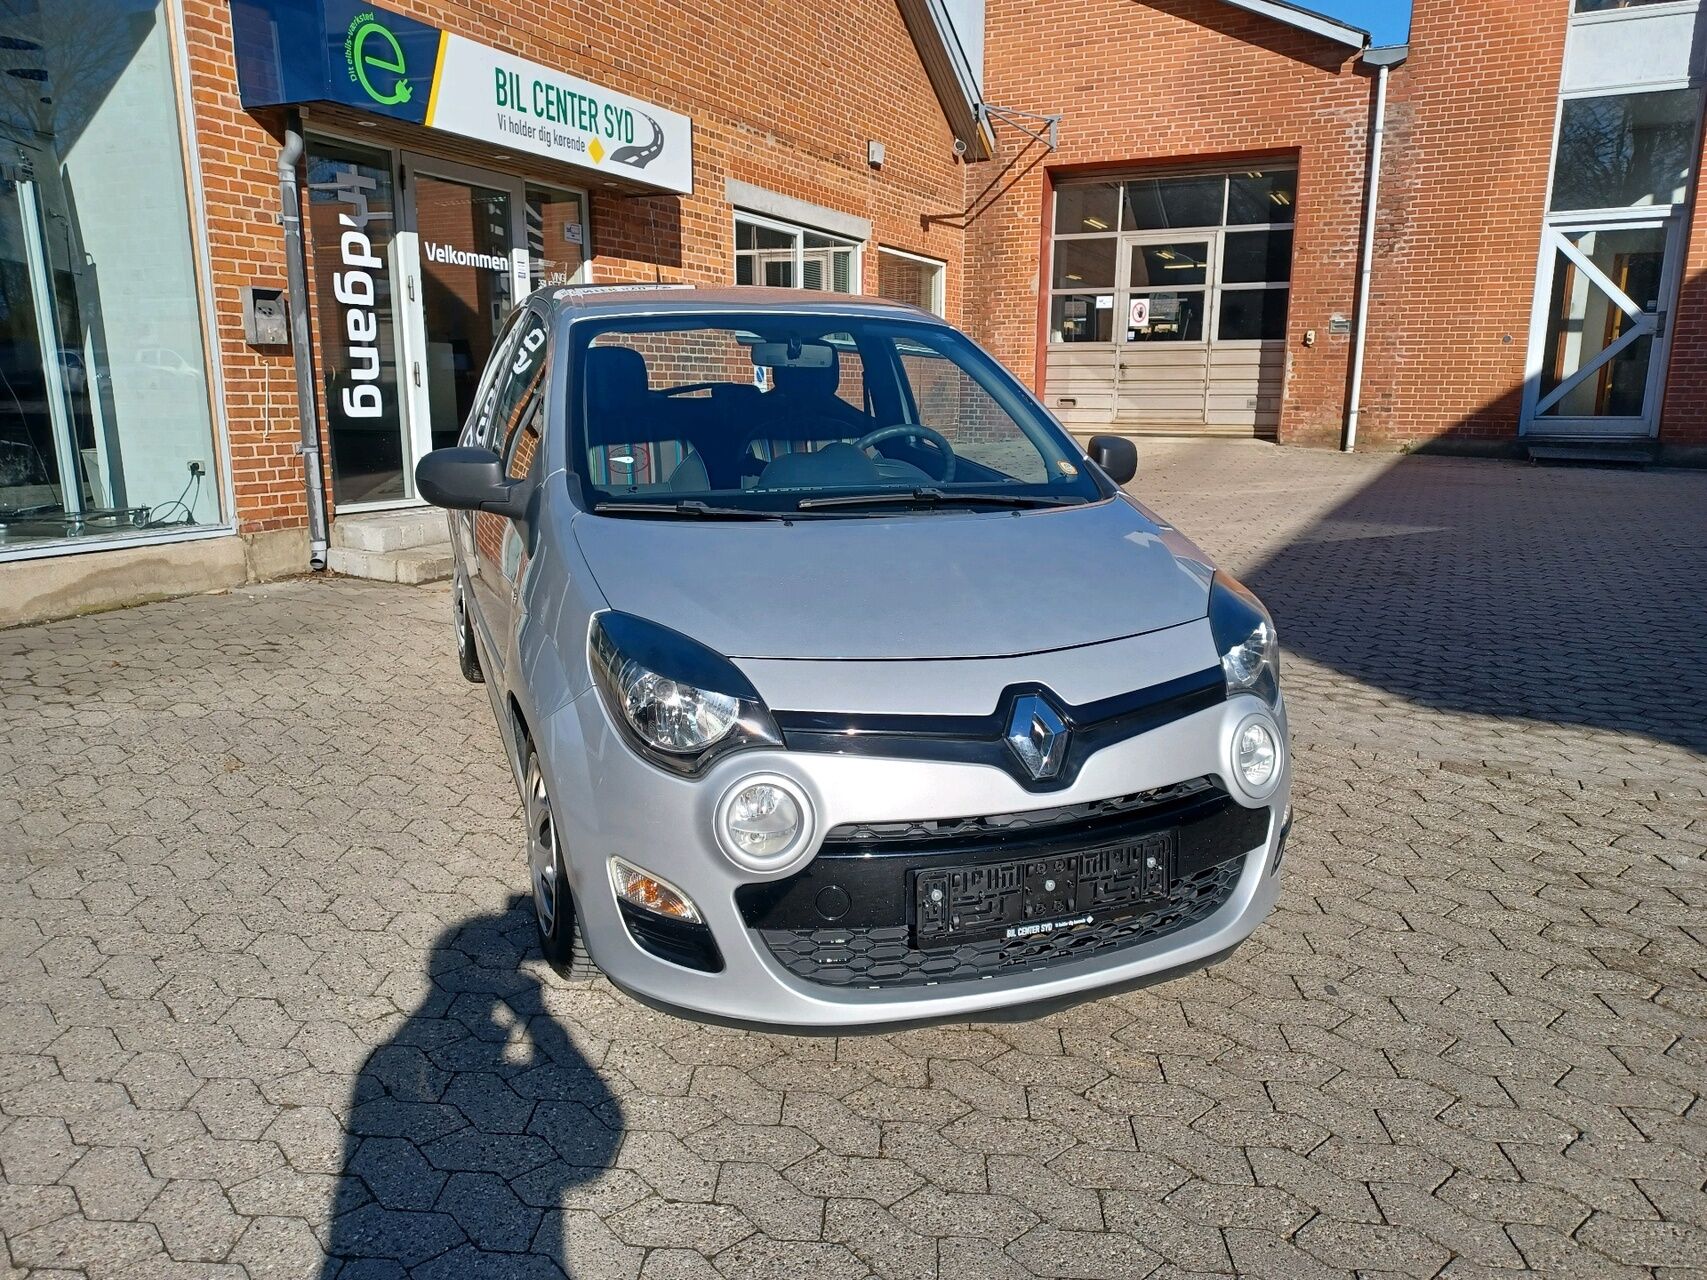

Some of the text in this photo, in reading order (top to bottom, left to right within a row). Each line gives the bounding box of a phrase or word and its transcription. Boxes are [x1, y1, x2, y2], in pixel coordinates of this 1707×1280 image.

[495, 66, 635, 145] BIL CENTER SYD
[497, 112, 586, 153] Vi holder dig kørende
[424, 241, 510, 272] Velkommen
